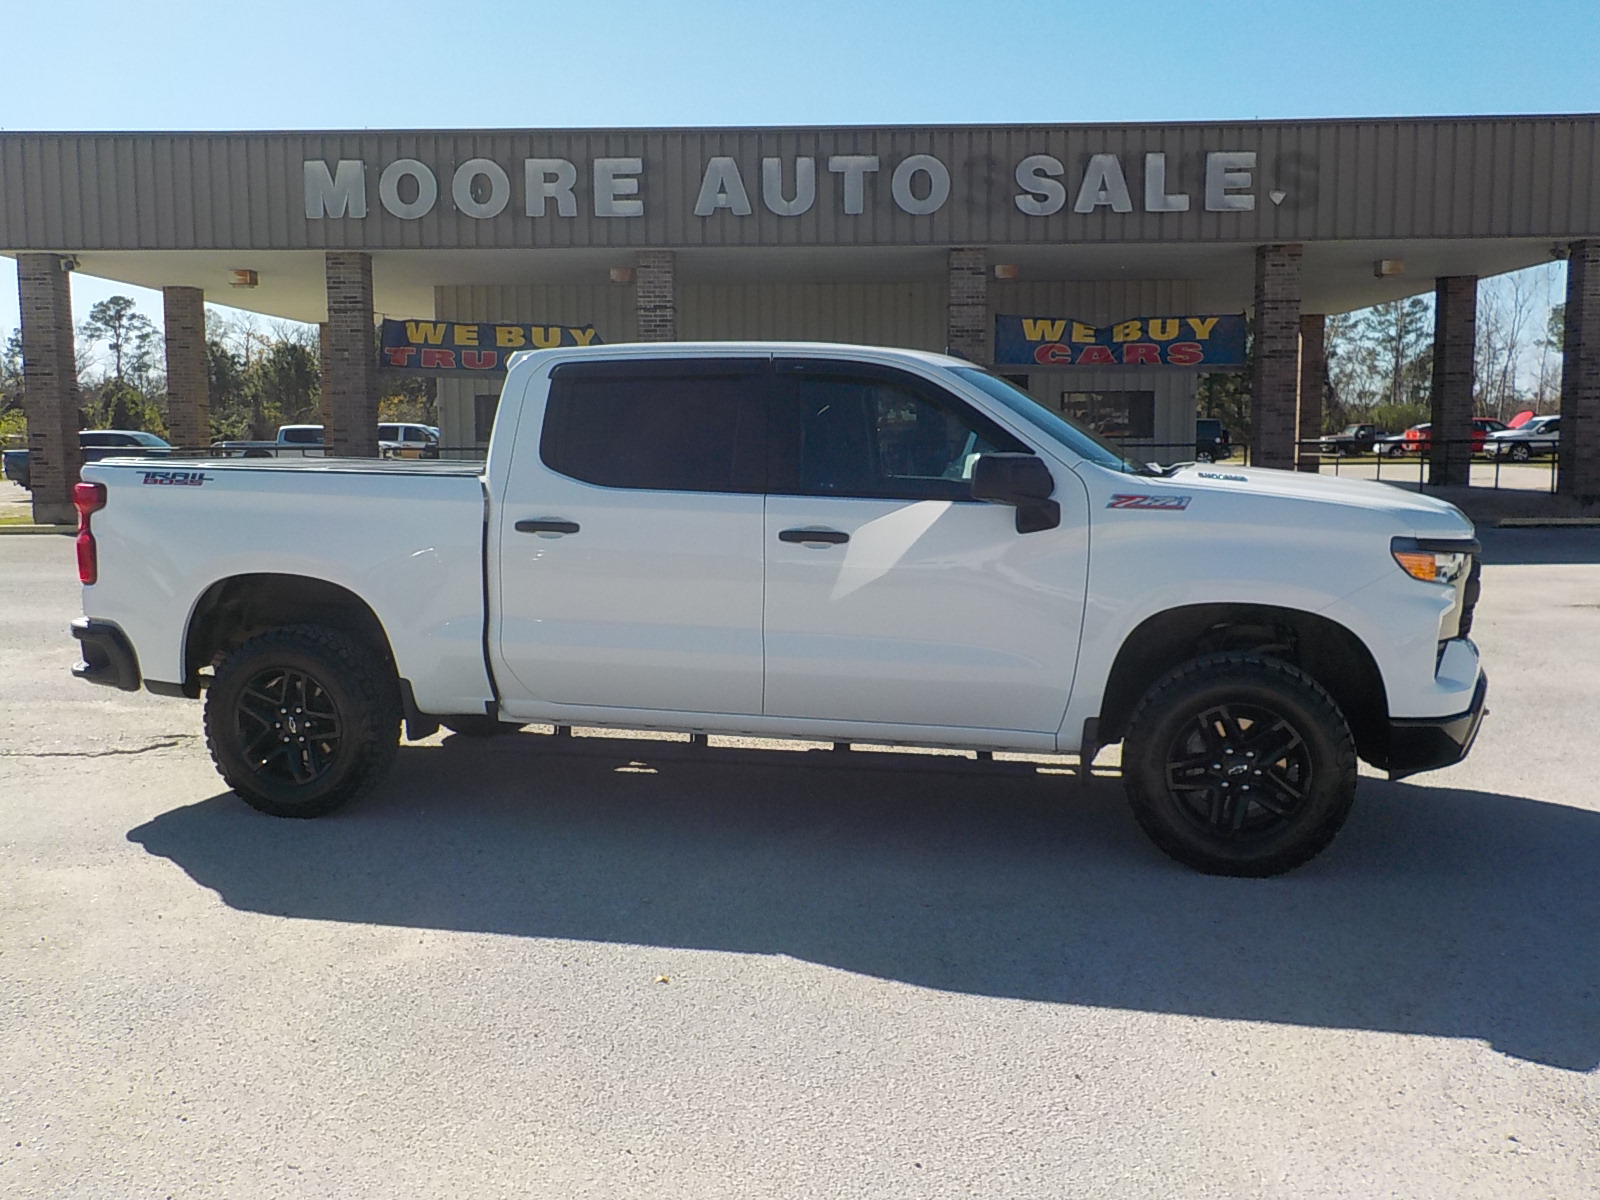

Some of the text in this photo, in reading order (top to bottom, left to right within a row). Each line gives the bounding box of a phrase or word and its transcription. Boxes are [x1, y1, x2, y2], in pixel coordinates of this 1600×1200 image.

[303, 151, 1257, 220] MOORE AUTO SALE
[405, 321, 597, 348] WE BUY
[1022, 317, 1220, 343] WE BUY
[384, 346, 512, 370] TRU
[1033, 342, 1205, 366] CARS
